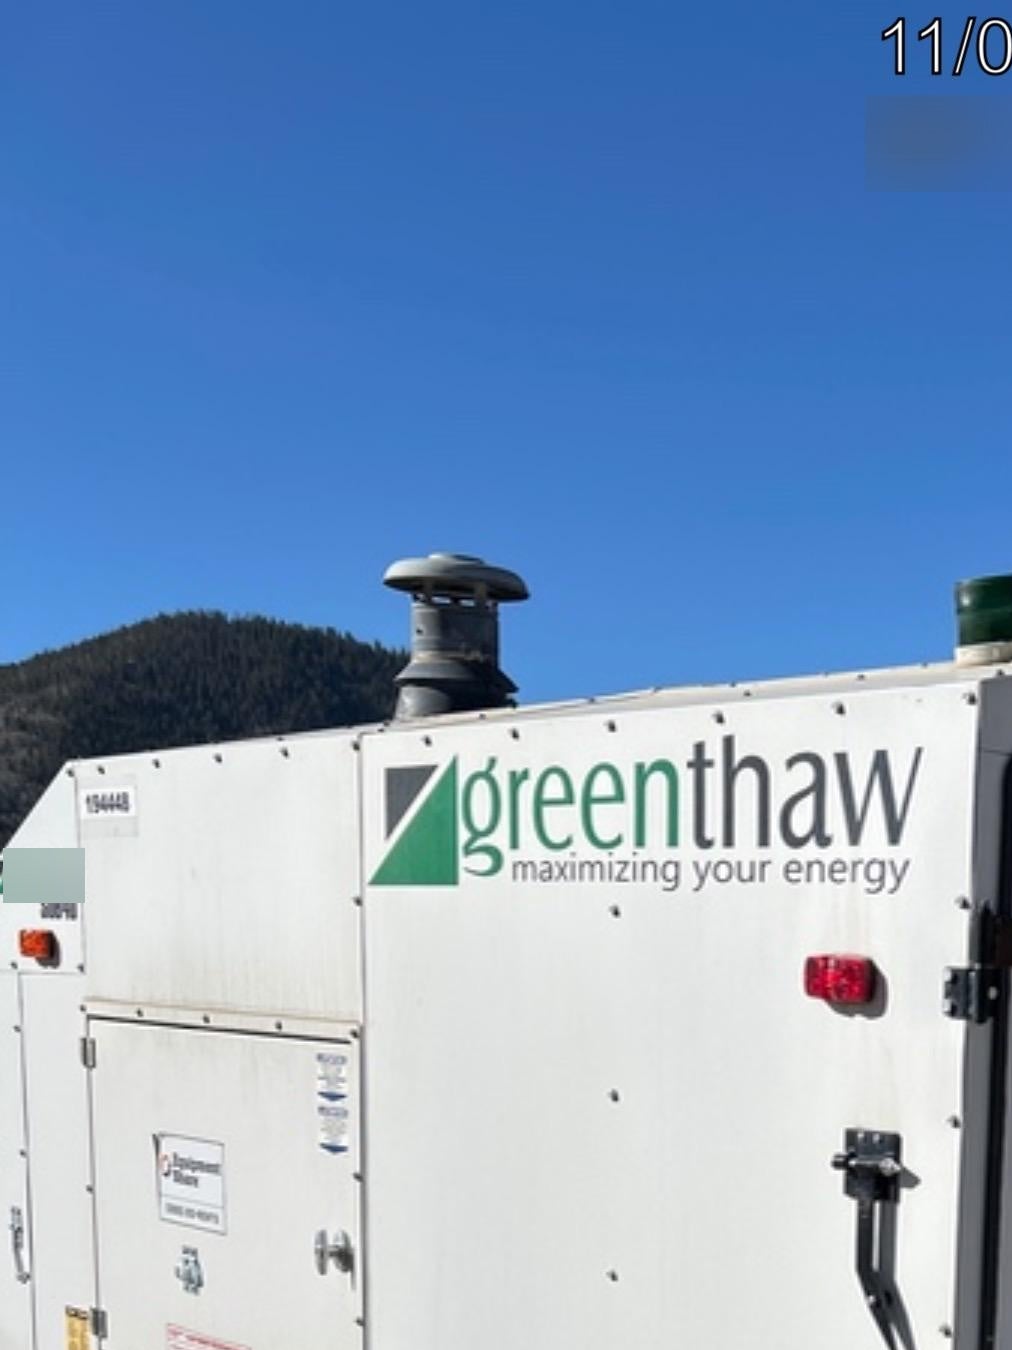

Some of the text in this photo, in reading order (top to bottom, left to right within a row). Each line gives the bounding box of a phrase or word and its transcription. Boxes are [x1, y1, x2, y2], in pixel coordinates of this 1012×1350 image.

[460, 734, 924, 877] greenthaw
[511, 852, 911, 895] maximizing your energy
